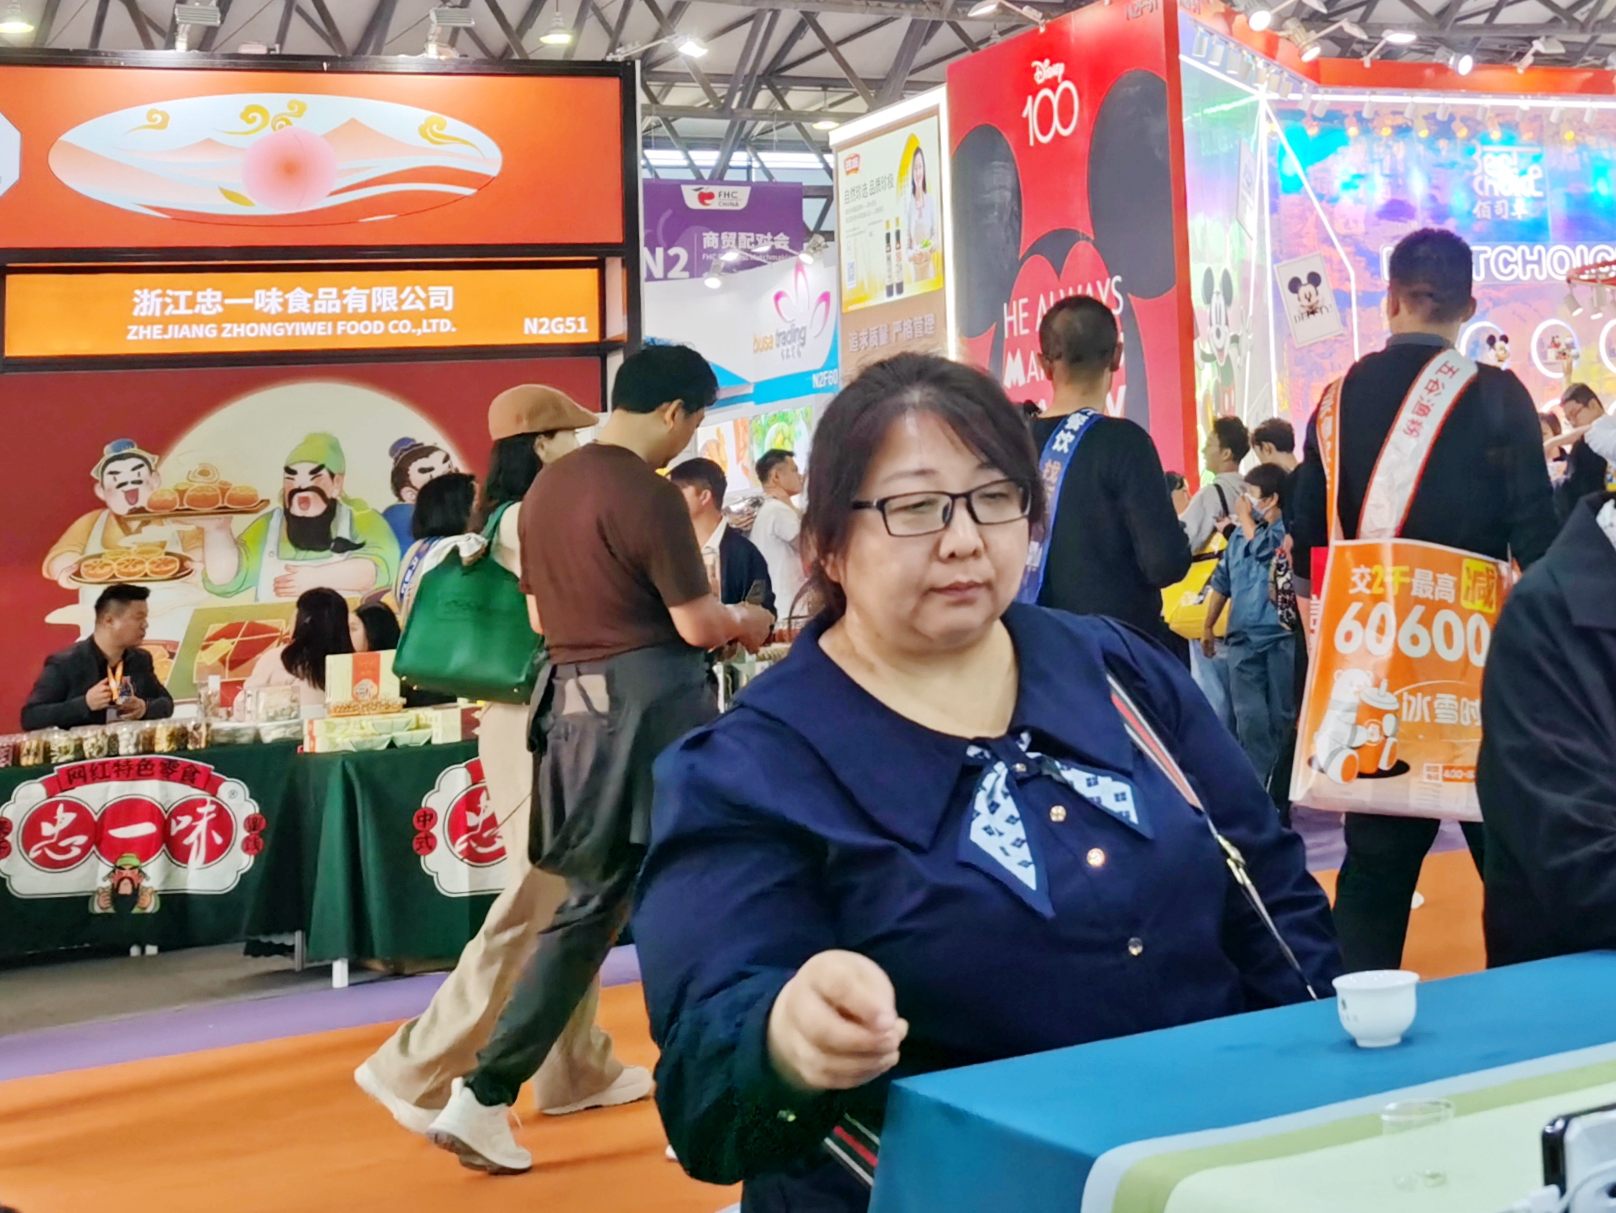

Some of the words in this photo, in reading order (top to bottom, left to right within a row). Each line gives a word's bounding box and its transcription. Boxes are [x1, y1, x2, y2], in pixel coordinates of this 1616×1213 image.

[1021, 80, 1080, 147] 100
[718, 190, 739, 199] FHC
[702, 230, 790, 250] 商贸配对会
[131, 285, 456, 318] 浙江忠一味食品有限公司
[126, 322, 218, 341] ZHEJIANG
[220, 321, 333, 338] ZHONGYIWEI
[336, 320, 385, 335] FOOD
[387, 318, 458, 336] CO.,LTD.
[523, 316, 589, 335] N2G51
[1003, 297, 1030, 339] HE
[66, 759, 202, 786] 网红特色零食
[28, 797, 224, 870] 忠一味
